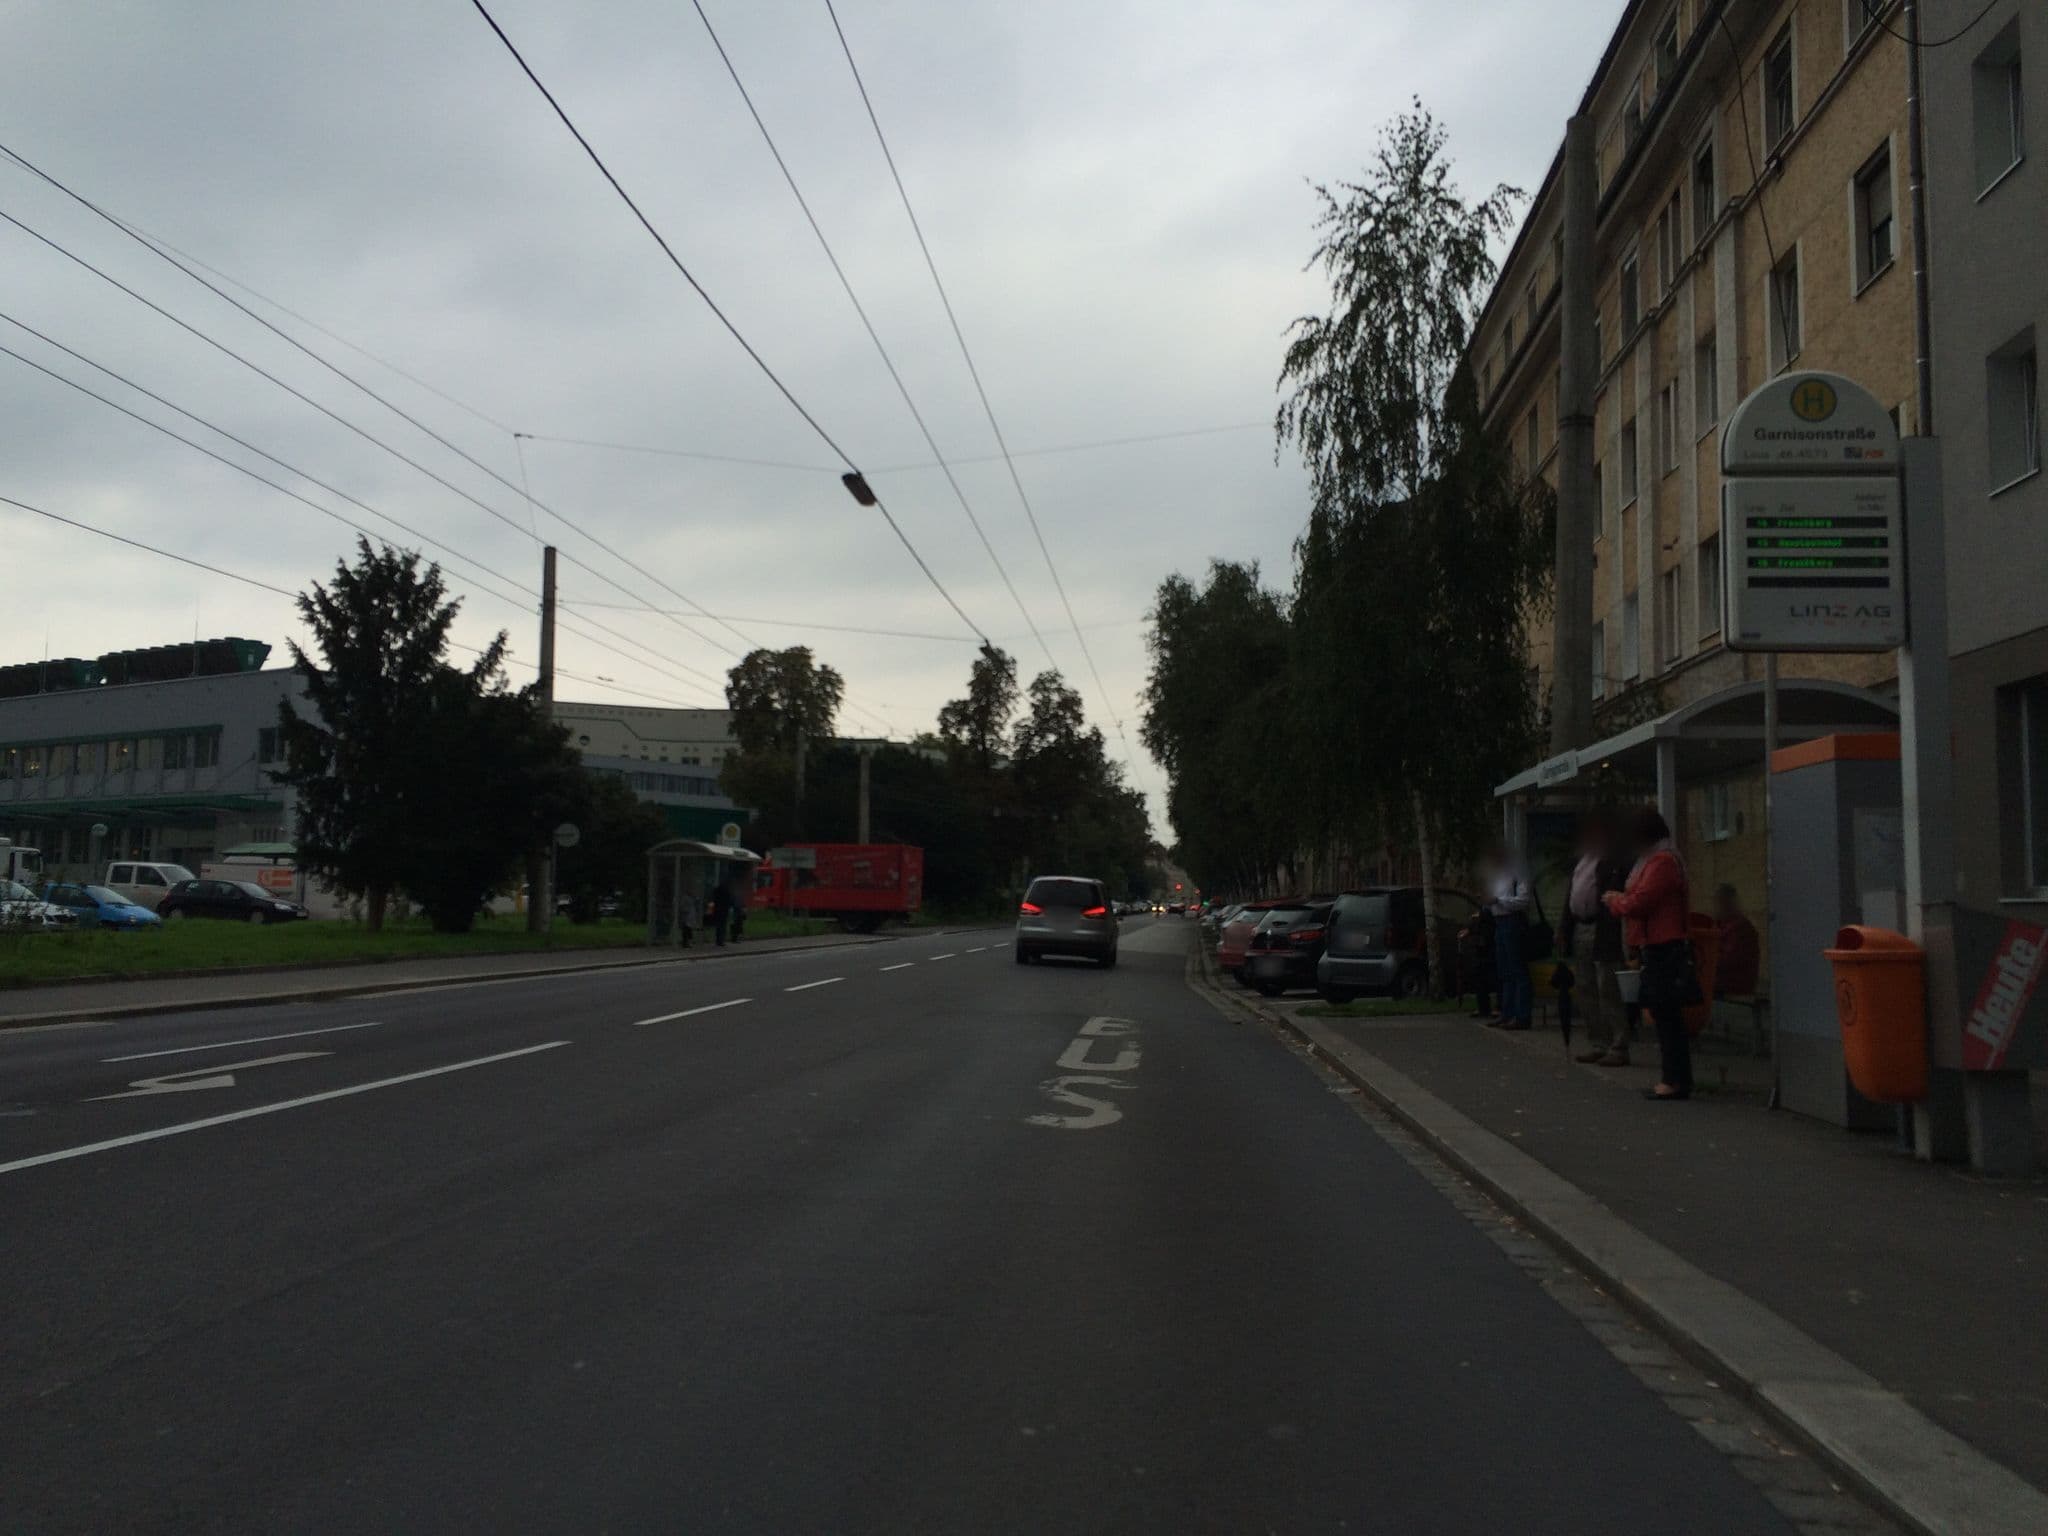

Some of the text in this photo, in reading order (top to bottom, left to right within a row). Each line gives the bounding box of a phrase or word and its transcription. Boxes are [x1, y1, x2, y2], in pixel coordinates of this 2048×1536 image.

[1753, 427, 1877, 442] Garnisonstraße
[1789, 602, 1892, 618] LINZ AG
[1967, 937, 2038, 1049] Heute
